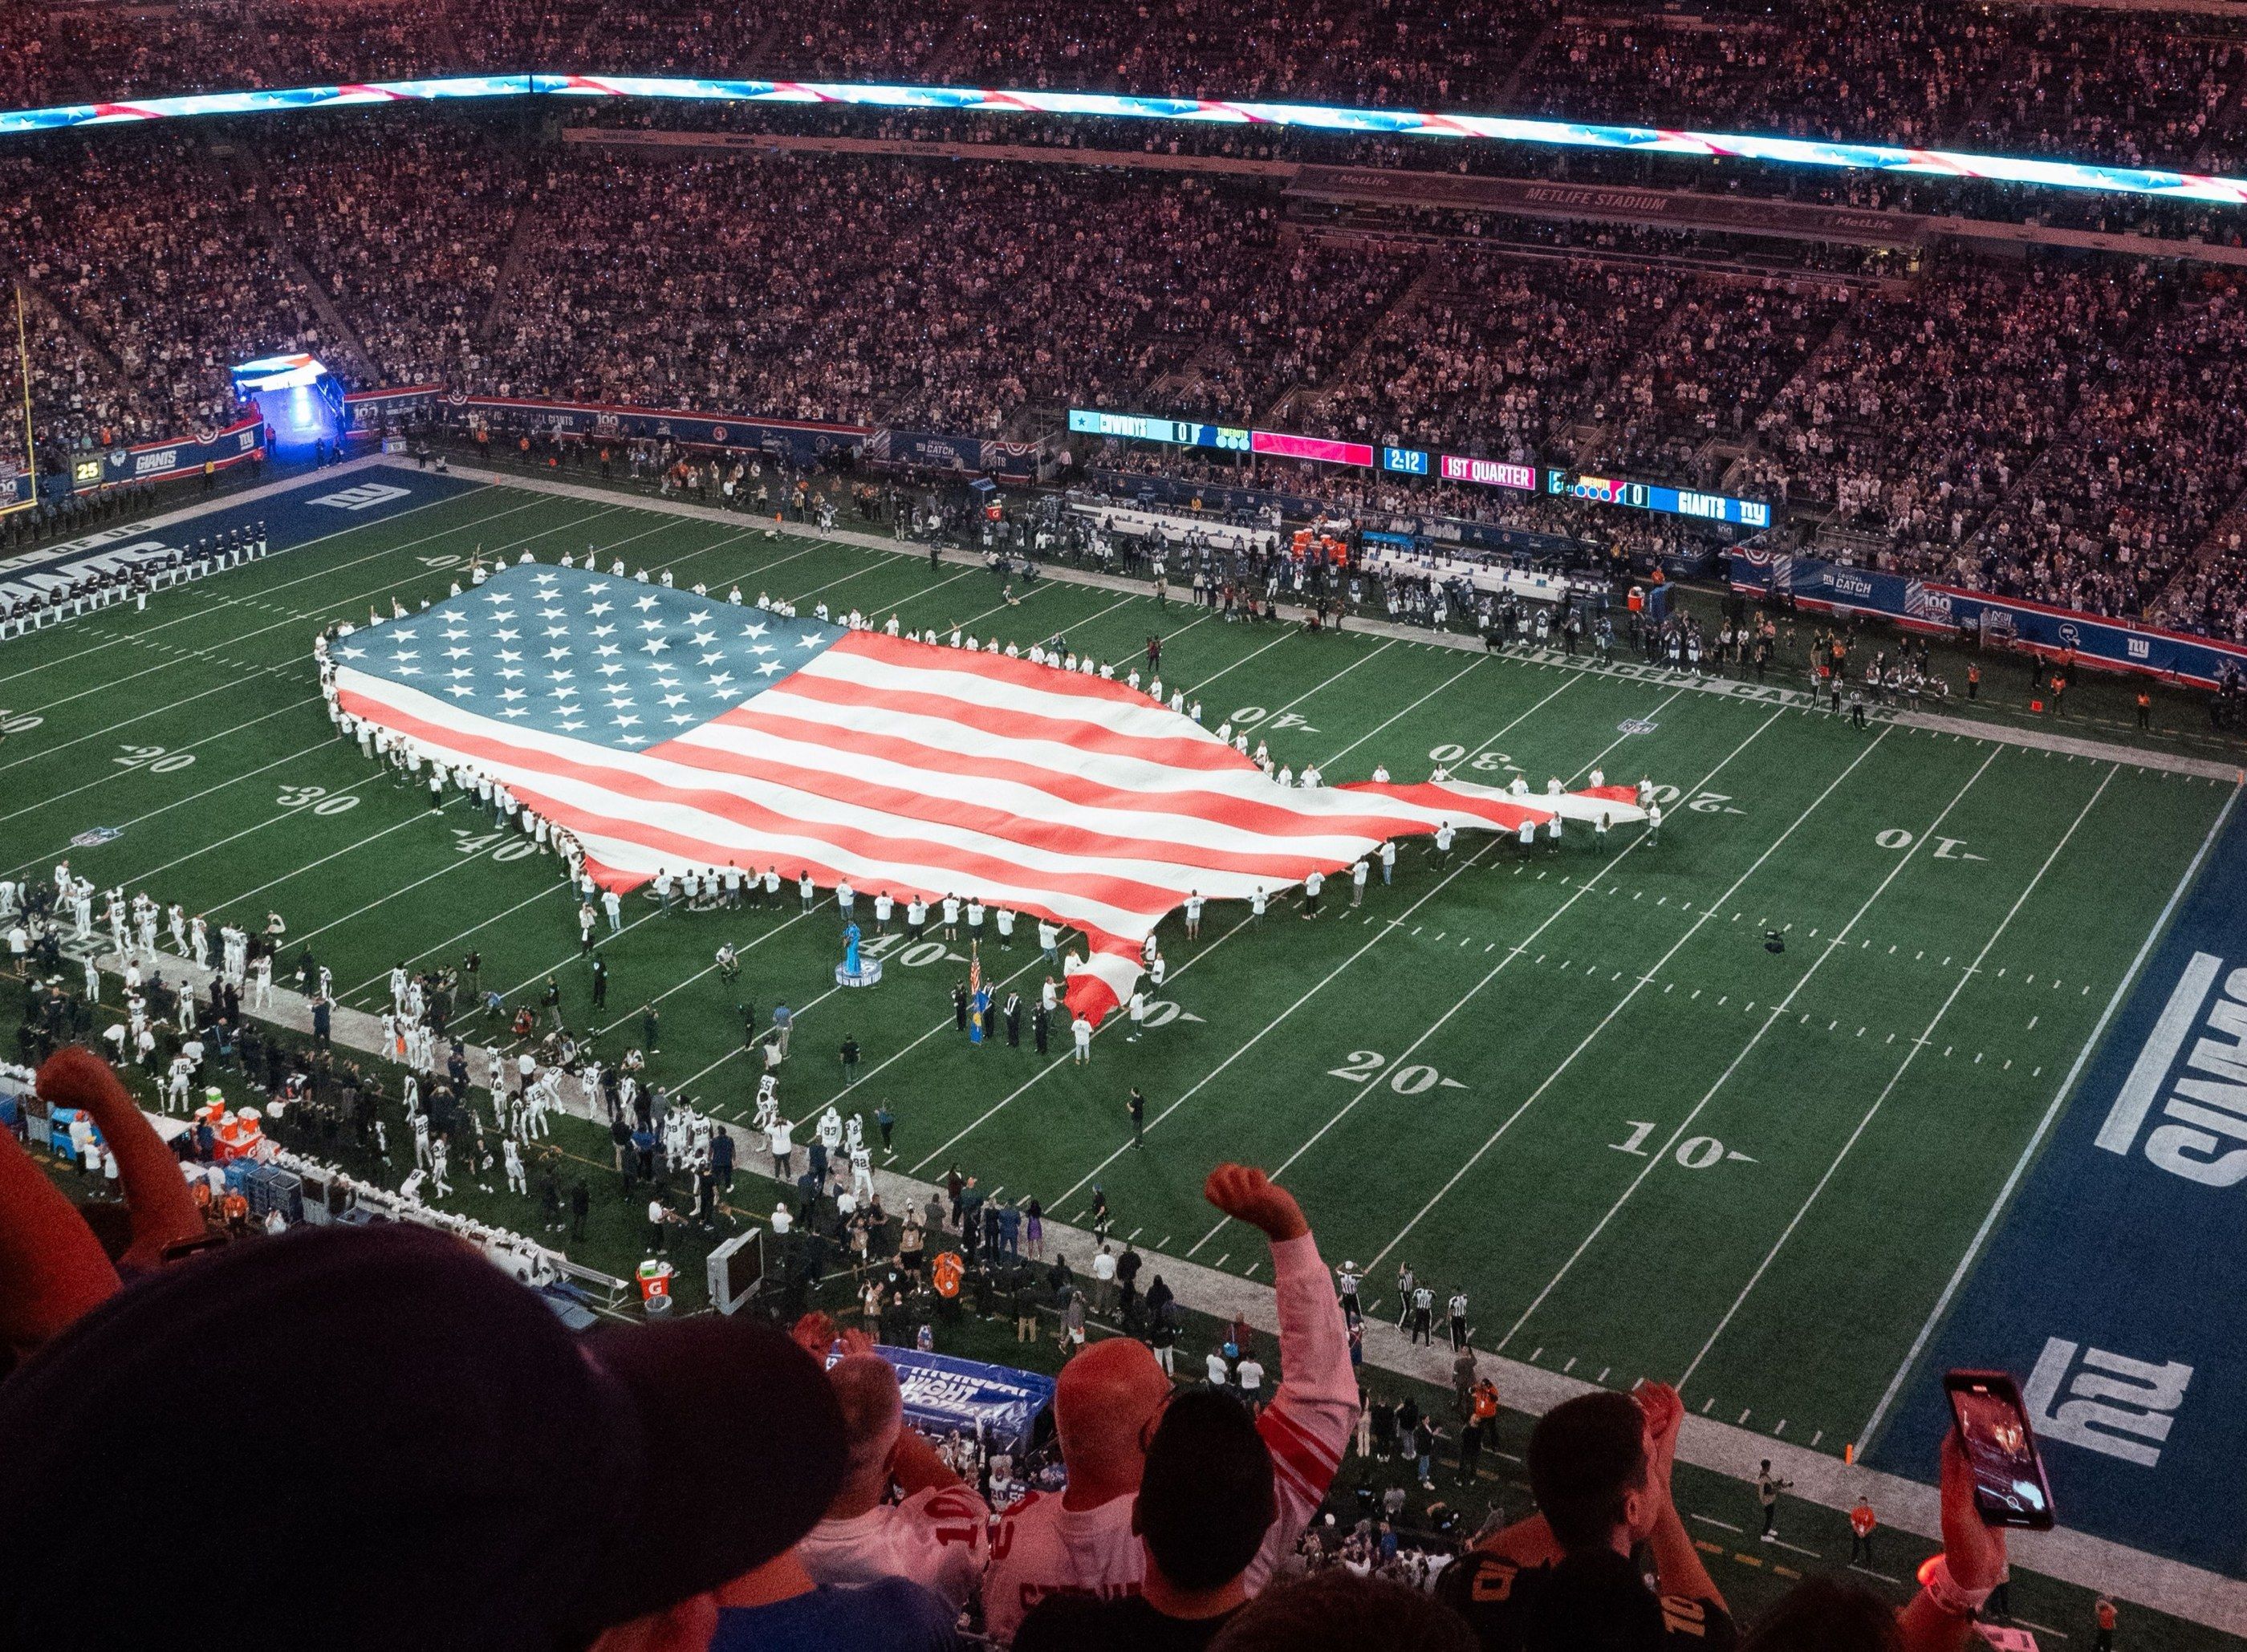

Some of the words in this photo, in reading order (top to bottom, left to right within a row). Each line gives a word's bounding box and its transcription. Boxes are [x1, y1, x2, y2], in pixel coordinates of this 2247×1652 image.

[1339, 174, 1390, 187] MetLife
[1525, 188, 1593, 205] METLIFE
[1594, 193, 1668, 211] STADIUM
[1835, 217, 1894, 229] MetLife
[1177, 422, 1188, 441] 0
[1217, 427, 1249, 440] TIMEOUTS
[136, 449, 177, 472] GIANTS
[927, 444, 955, 456] CATCH
[1391, 449, 1420, 472] 2:12
[77, 461, 99, 480] 25
[1447, 457, 1469, 478] 1ST
[1472, 462, 1530, 487] QUARTER
[1631, 485, 1643, 505] 0
[1677, 491, 1726, 520] GIANTS
[1835, 578, 1872, 594] CATCH
[1924, 595, 1952, 611] 100
[1538, 617, 1546, 626] 72
[112, 745, 197, 773] 20
[1428, 744, 1511, 771] 30
[276, 785, 361, 815] 30
[453, 832, 539, 862] 40
[1875, 828, 1968, 859] 10
[182, 992, 193, 1002] 42
[176, 1064, 187, 1075] 19
[1327, 1050, 1439, 1094] 20
[695, 1125, 709, 1136] 58
[823, 1126, 837, 1136] 93
[1607, 1120, 1725, 1169] 10
[648, 1281, 662, 1295] G
[900, 1374, 979, 1403] NIGHT
[923, 1495, 979, 1550] 10
[1660, 1596, 1707, 1638] 10
